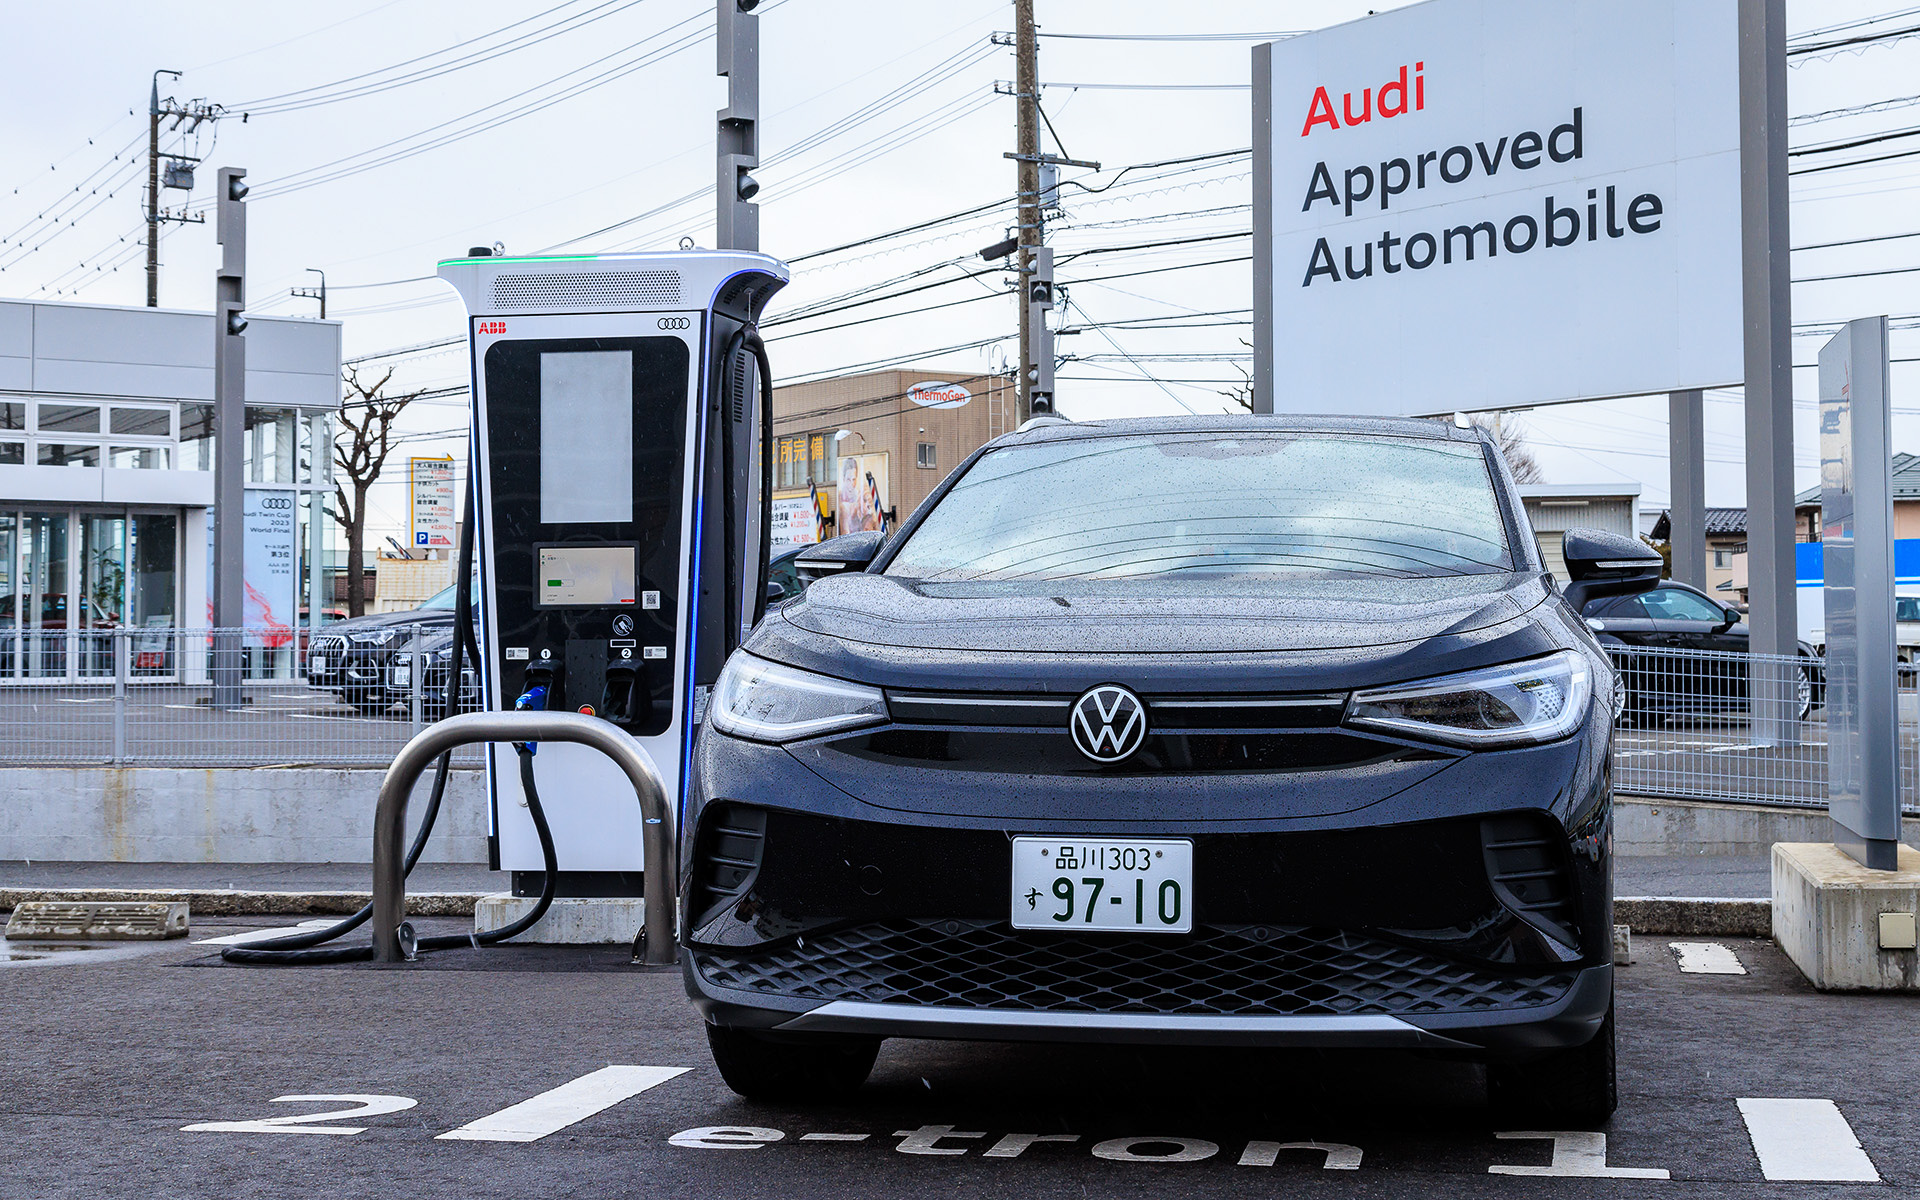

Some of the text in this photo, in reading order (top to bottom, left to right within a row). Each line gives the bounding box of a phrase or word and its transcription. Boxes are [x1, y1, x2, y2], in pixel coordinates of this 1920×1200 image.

[1301, 61, 1424, 137] Audi
[1301, 106, 1583, 217] Approved
[1302, 184, 1664, 287] Automobile
[478, 321, 507, 334] ABB
[912, 387, 966, 402] ThermoGen
[418, 533, 426, 543] P
[1024, 876, 1182, 925] す 97-10
[179, 1093, 418, 1136] 2
[667, 1124, 1671, 1180] e-tron 1
